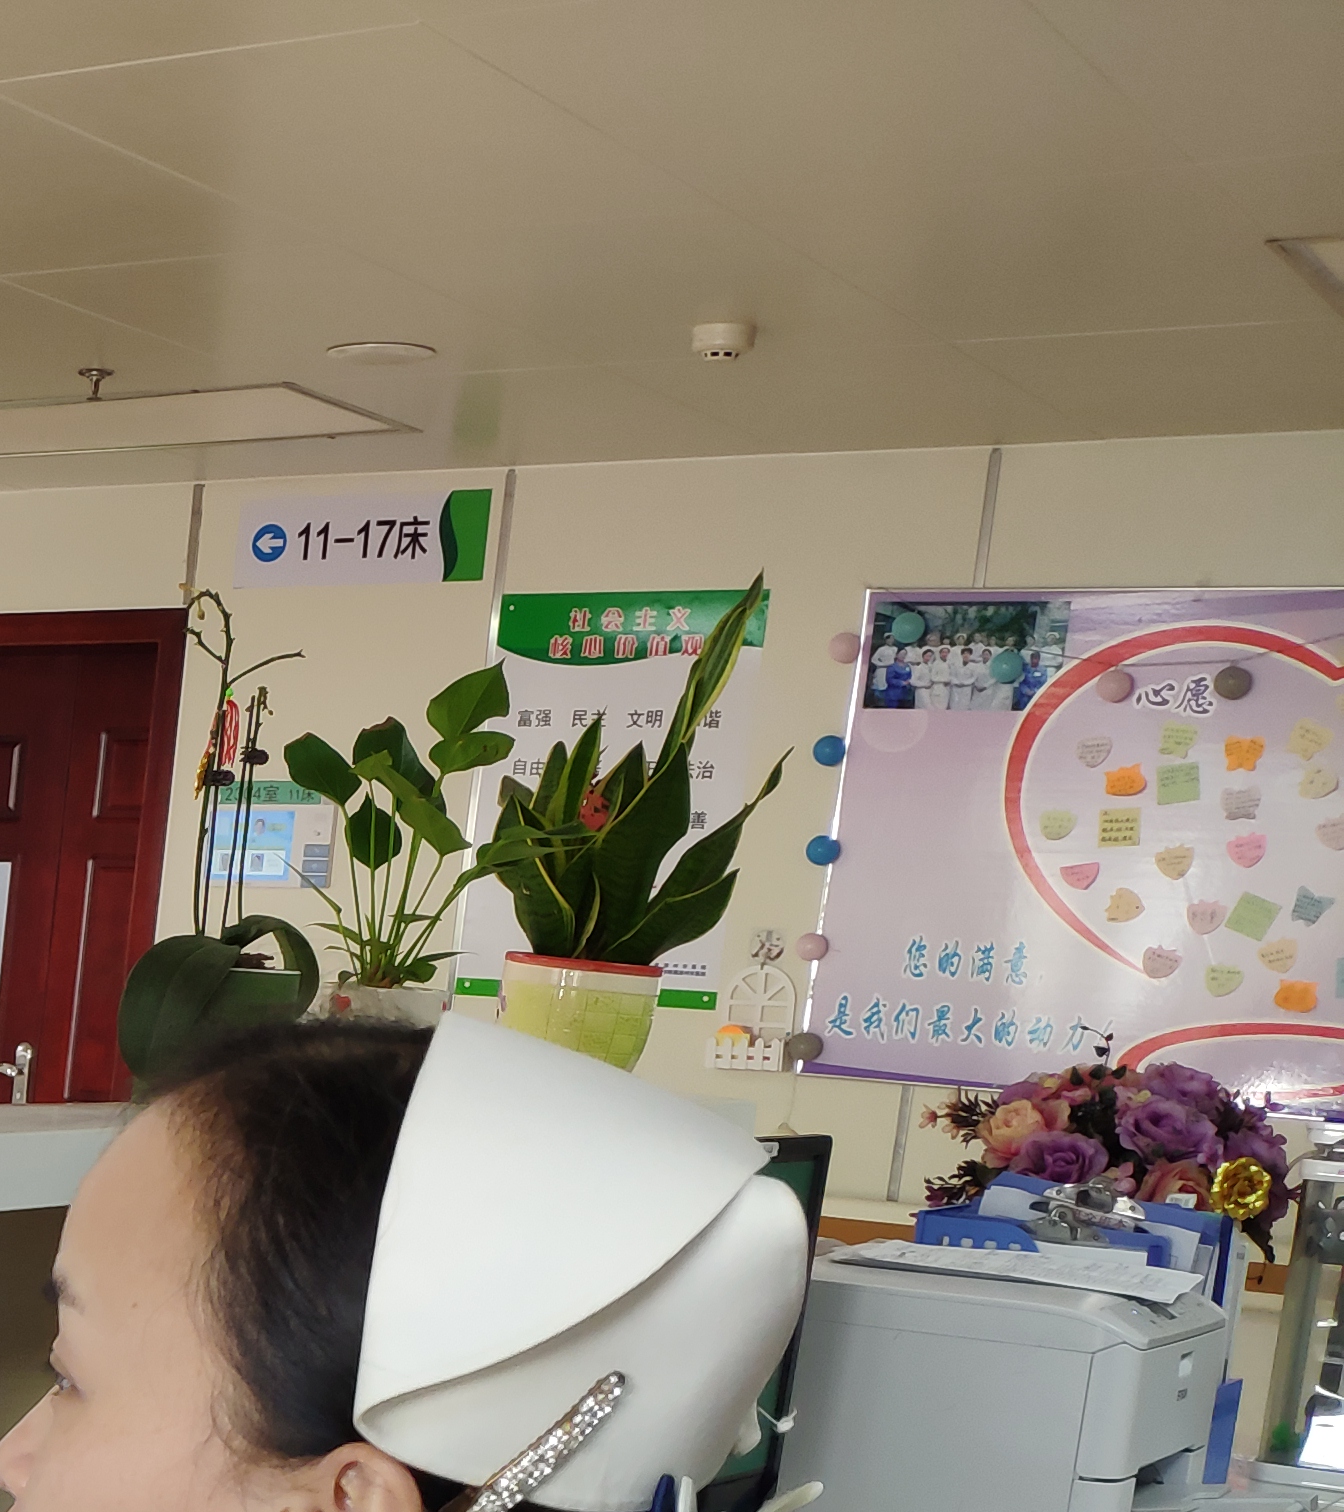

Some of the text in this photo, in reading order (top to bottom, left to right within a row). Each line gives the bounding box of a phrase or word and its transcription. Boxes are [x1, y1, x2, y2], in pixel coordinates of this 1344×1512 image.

[296, 516, 431, 562] 11-17床
[568, 607, 691, 632] 社会主义
[549, 635, 704, 659] 核心价值观
[1135, 677, 1215, 715] 心愿
[517, 709, 552, 728] 富强
[626, 709, 664, 729] 文明
